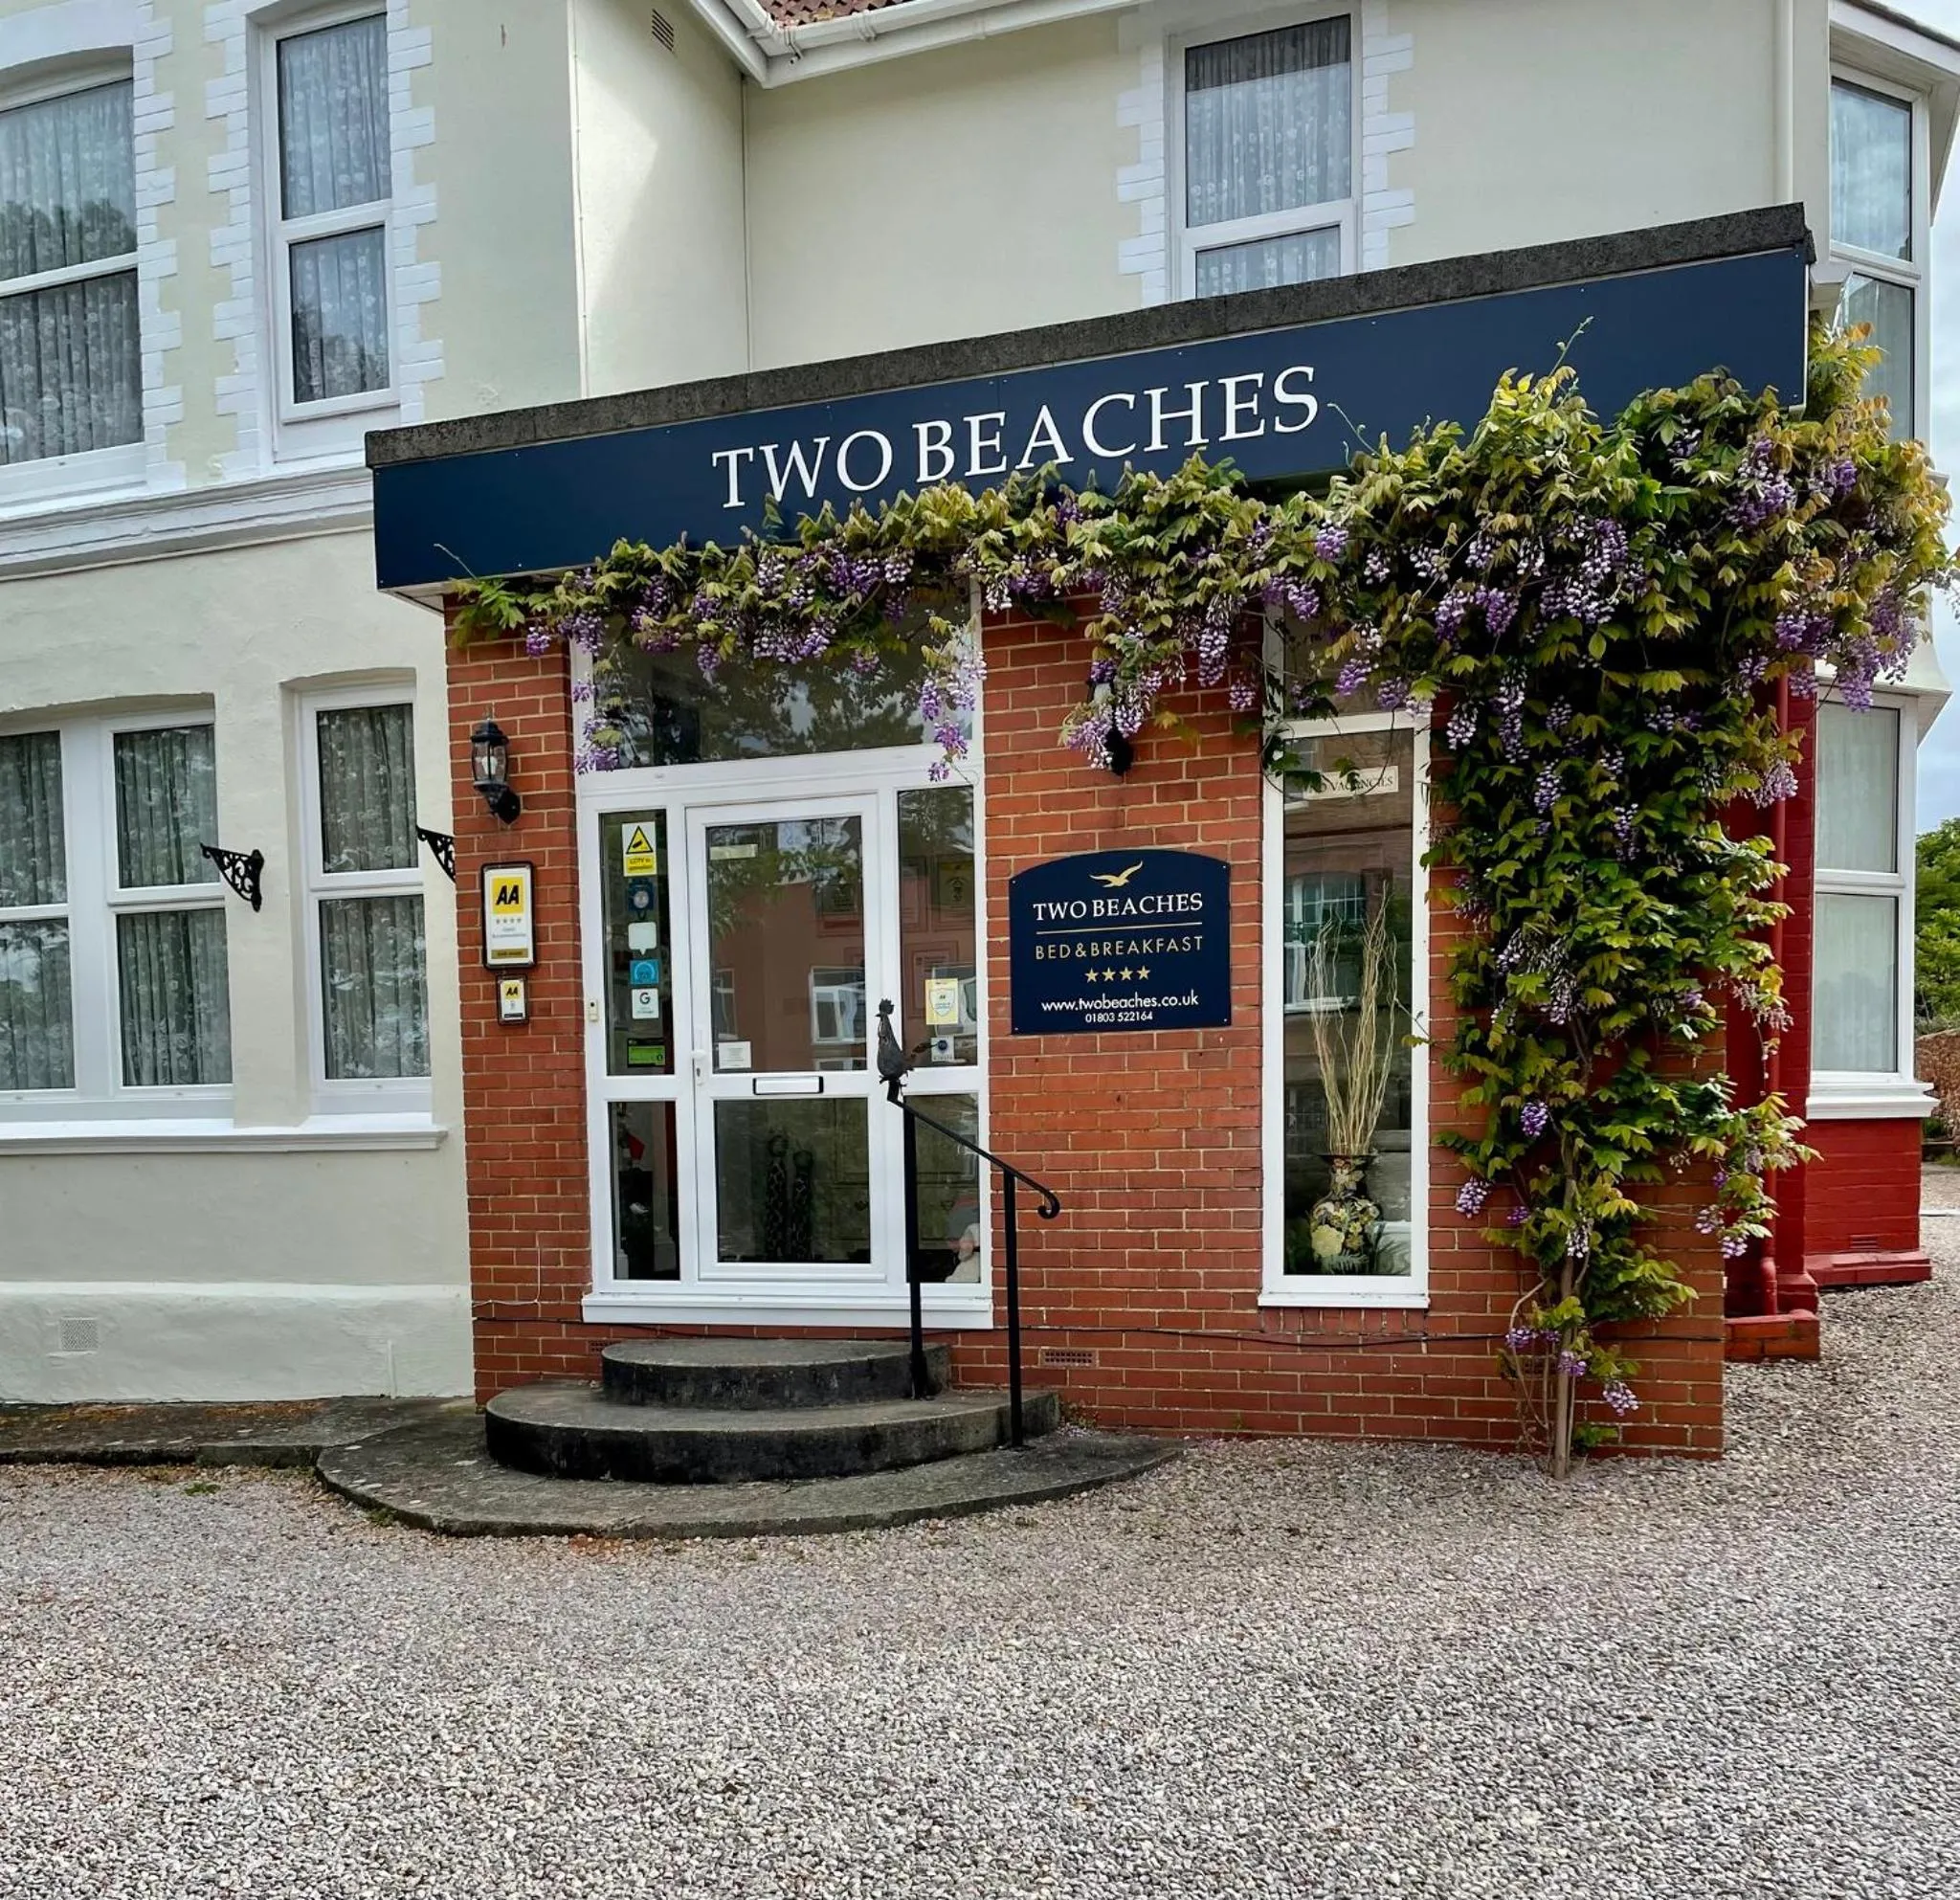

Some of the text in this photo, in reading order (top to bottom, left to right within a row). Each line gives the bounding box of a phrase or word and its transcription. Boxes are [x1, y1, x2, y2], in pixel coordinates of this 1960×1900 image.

[711, 366, 1319, 508] TWO BEACHES
[495, 884, 520, 905] AA
[1033, 892, 1203, 921] TWO BEACHES
[505, 986, 519, 996] AA
[639, 992, 651, 1005] G
[1040, 989, 1199, 1012] www.twobeaches.co.uk
[1084, 1010, 1153, 1023] 01803 522164
